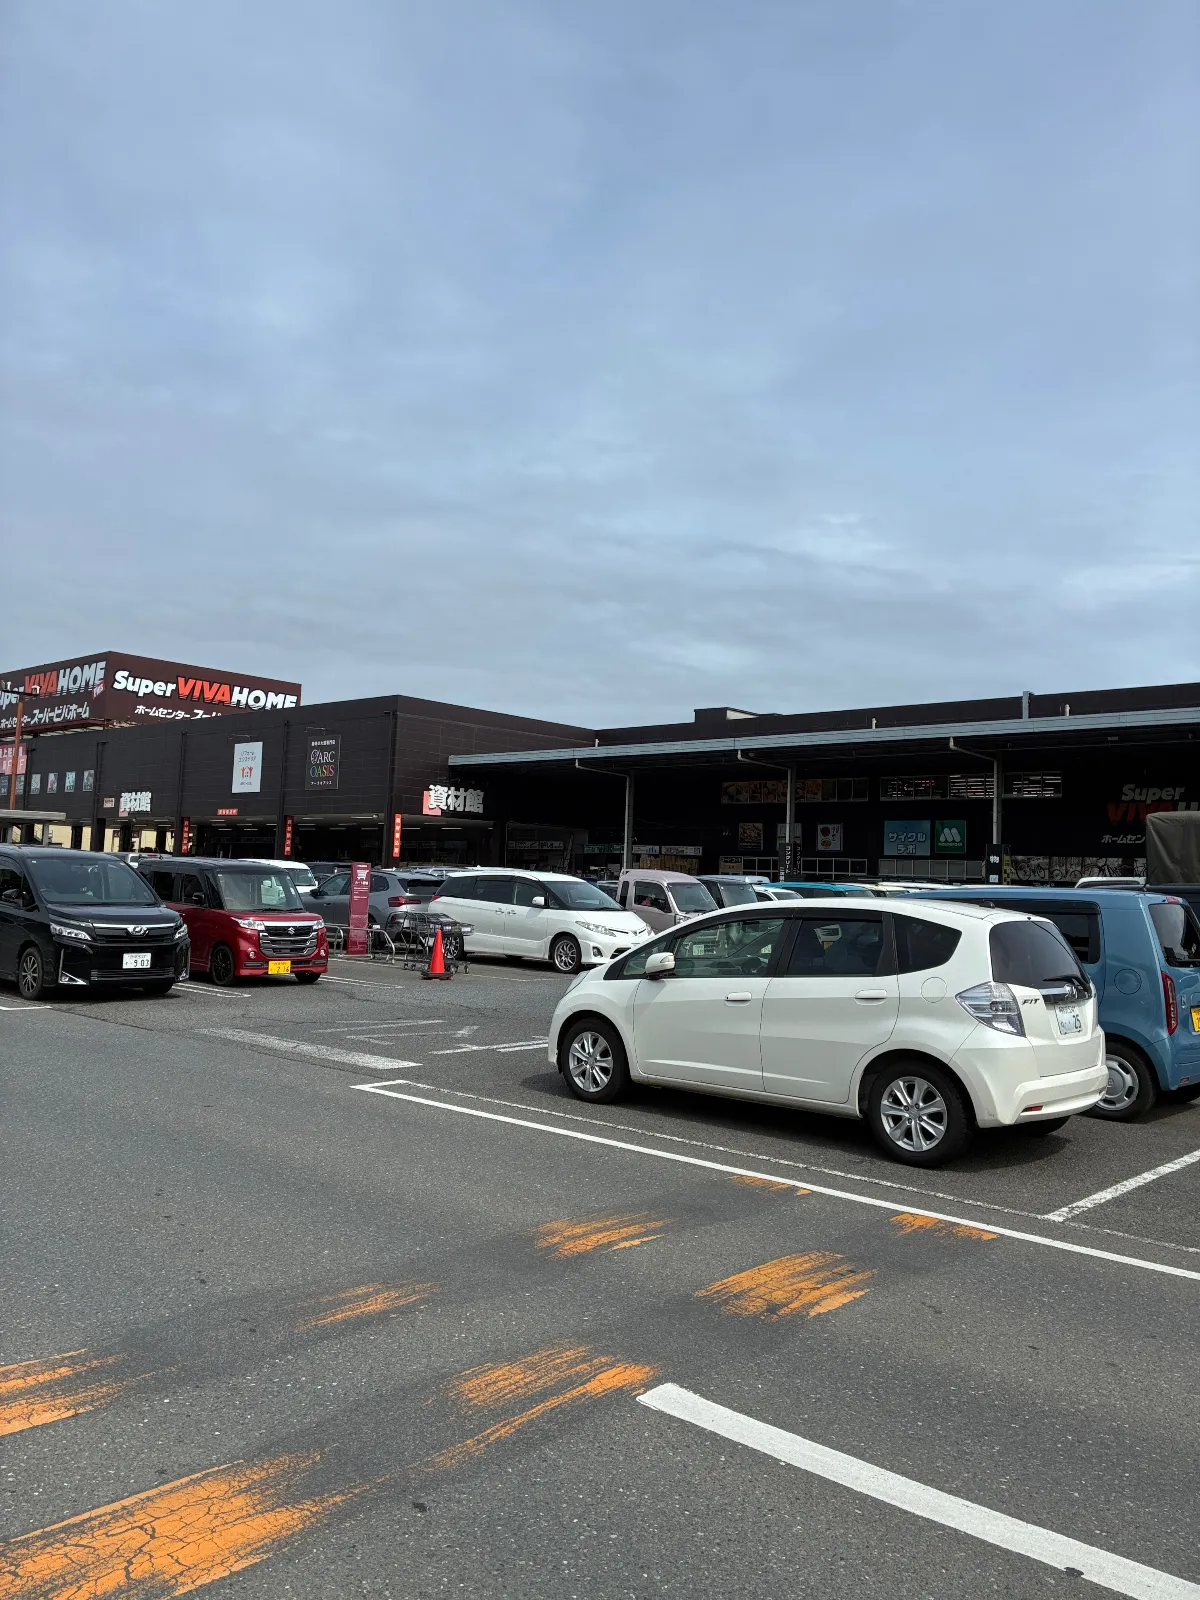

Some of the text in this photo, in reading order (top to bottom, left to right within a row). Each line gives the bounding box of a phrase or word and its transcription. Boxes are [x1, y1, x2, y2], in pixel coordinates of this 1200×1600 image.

[113, 670, 176, 697] Super
[317, 751, 335, 763] ARC
[310, 765, 334, 777] OASIS
[121, 791, 151, 812] 資材館
[428, 785, 484, 813] 資材館
[1121, 783, 1186, 804] Super
[888, 832, 926, 842] サイクル
[1021, 998, 1040, 1006] FIT
